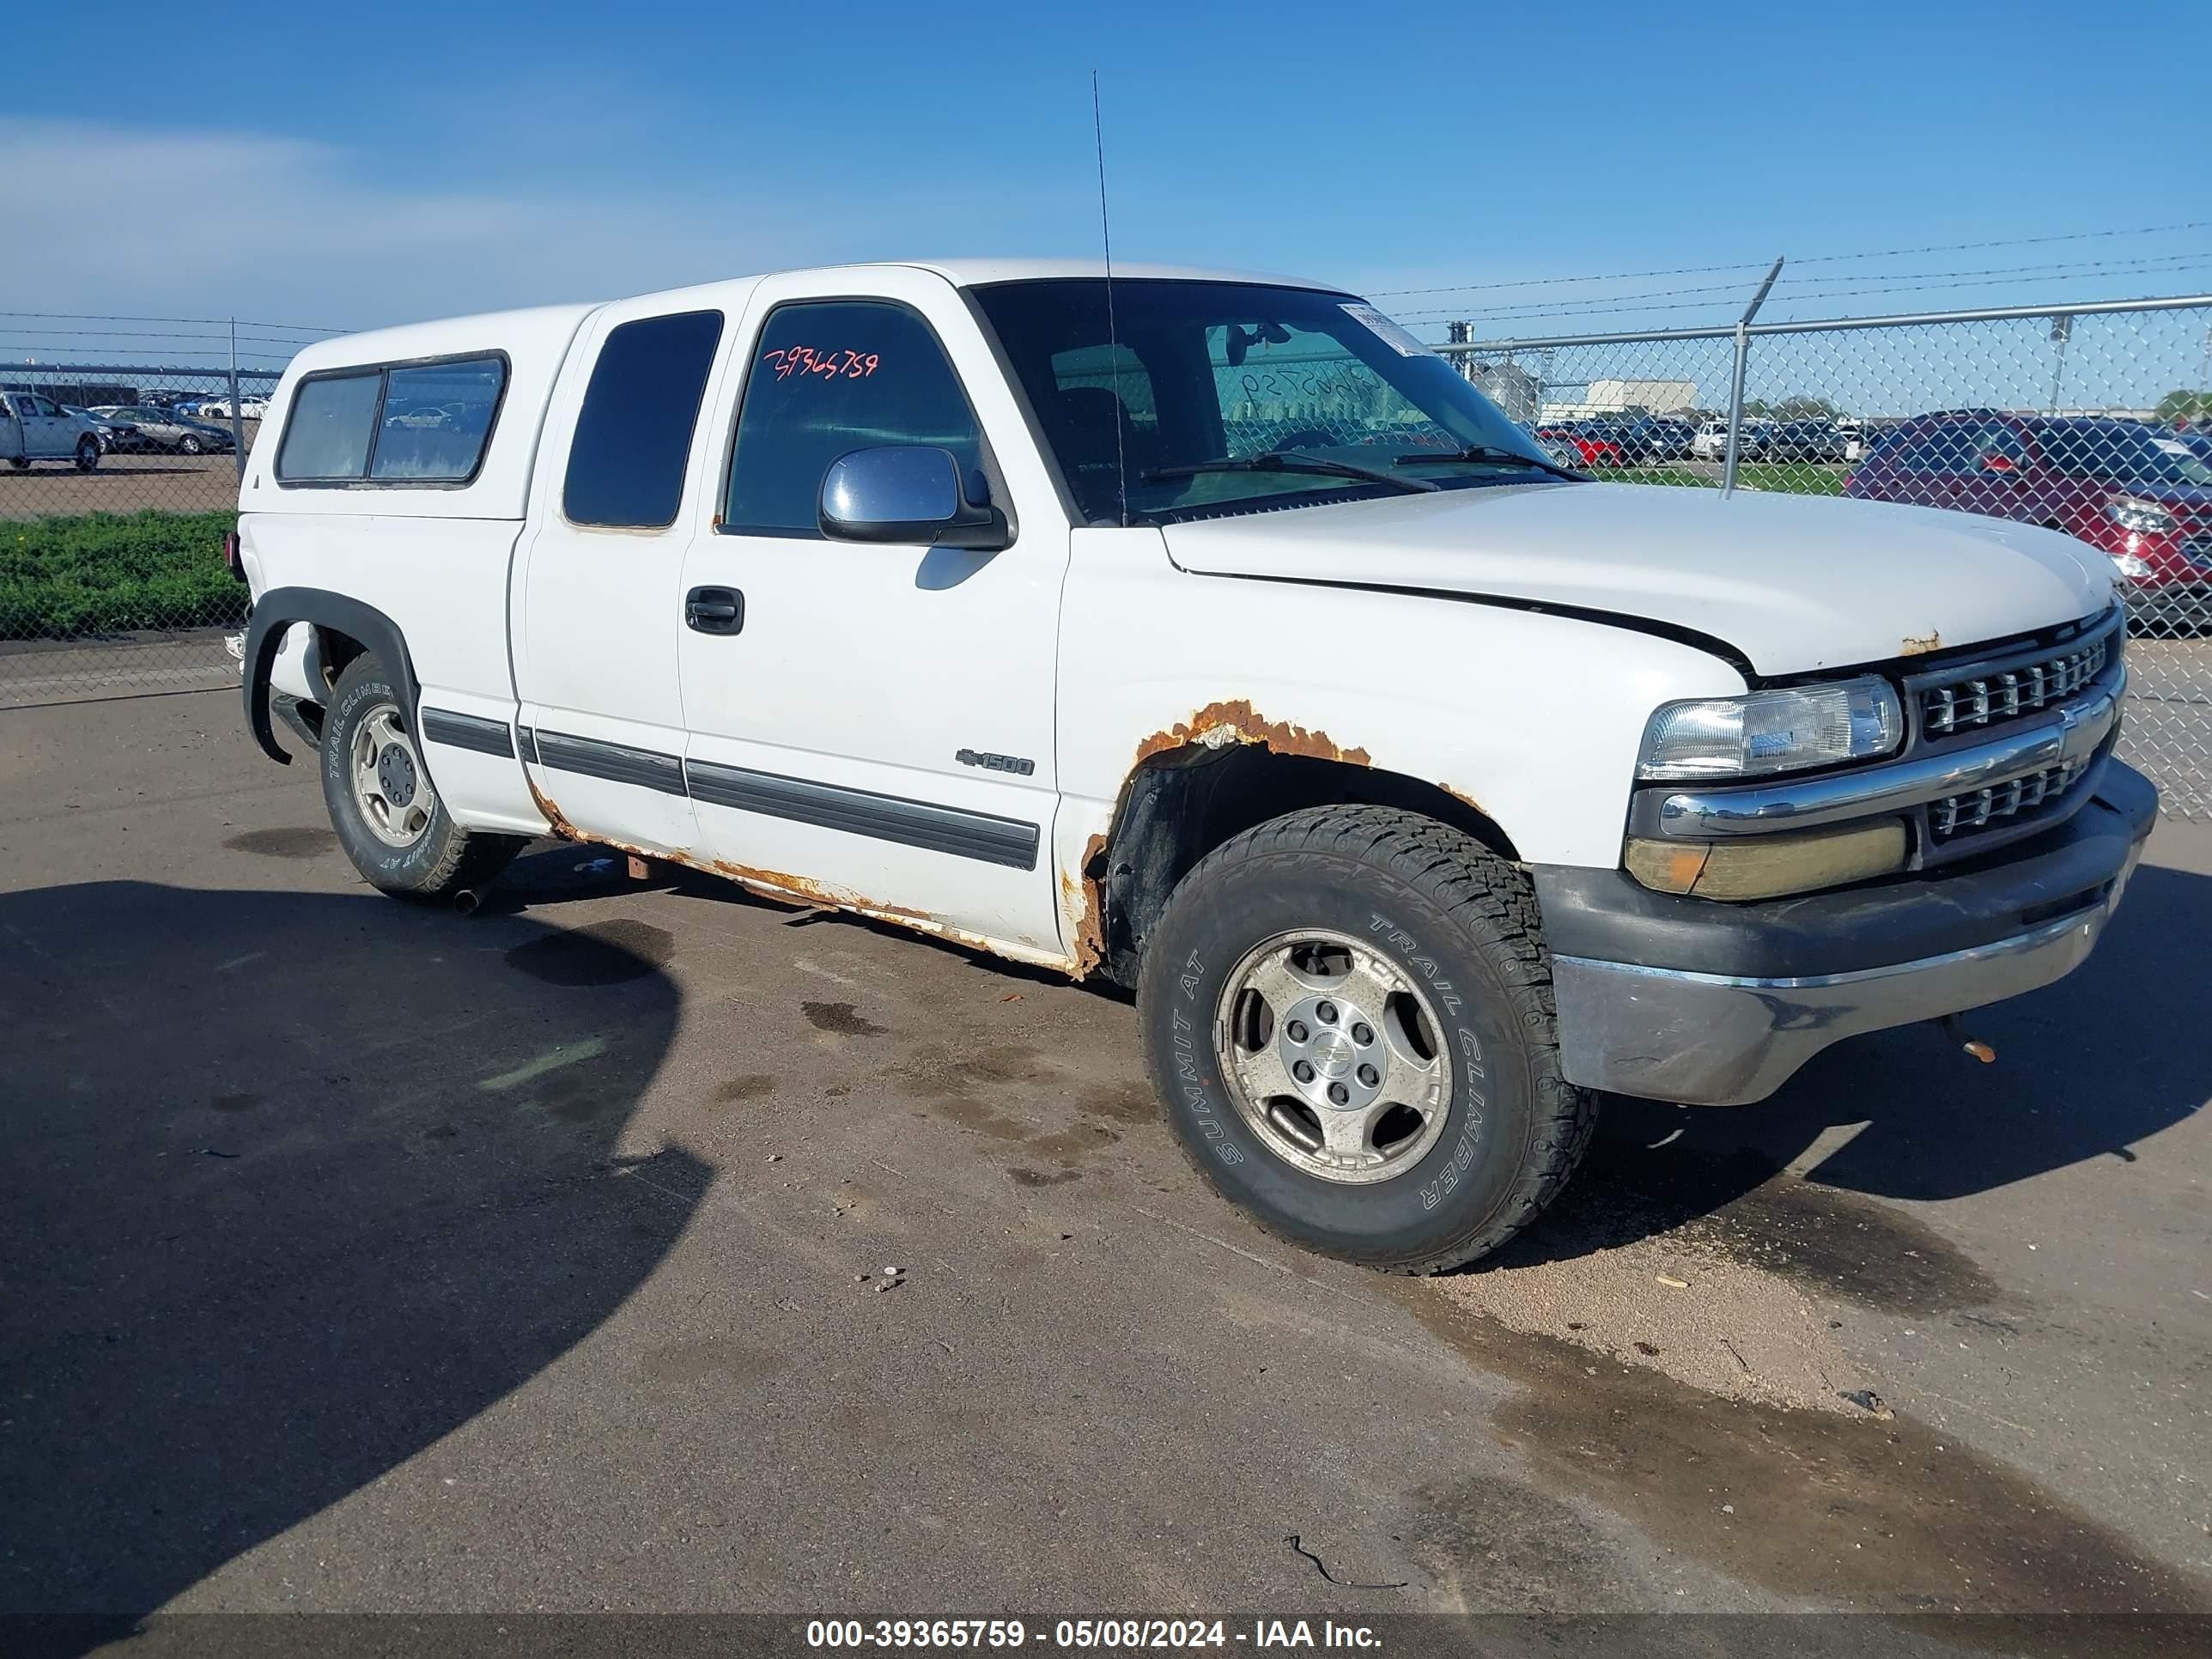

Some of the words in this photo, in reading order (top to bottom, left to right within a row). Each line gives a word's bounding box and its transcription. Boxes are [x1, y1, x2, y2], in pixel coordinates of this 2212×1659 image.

[763, 346, 879, 381] 39365759
[329, 719, 345, 780] TRAIL
[981, 752, 1036, 776] 1500
[1181, 949, 1206, 1000] AT
[1370, 915, 1462, 1017] TRAIL
[1173, 1008, 1244, 1165] SUMMIT
[1402, 1028, 1486, 1212] CLIMBER
